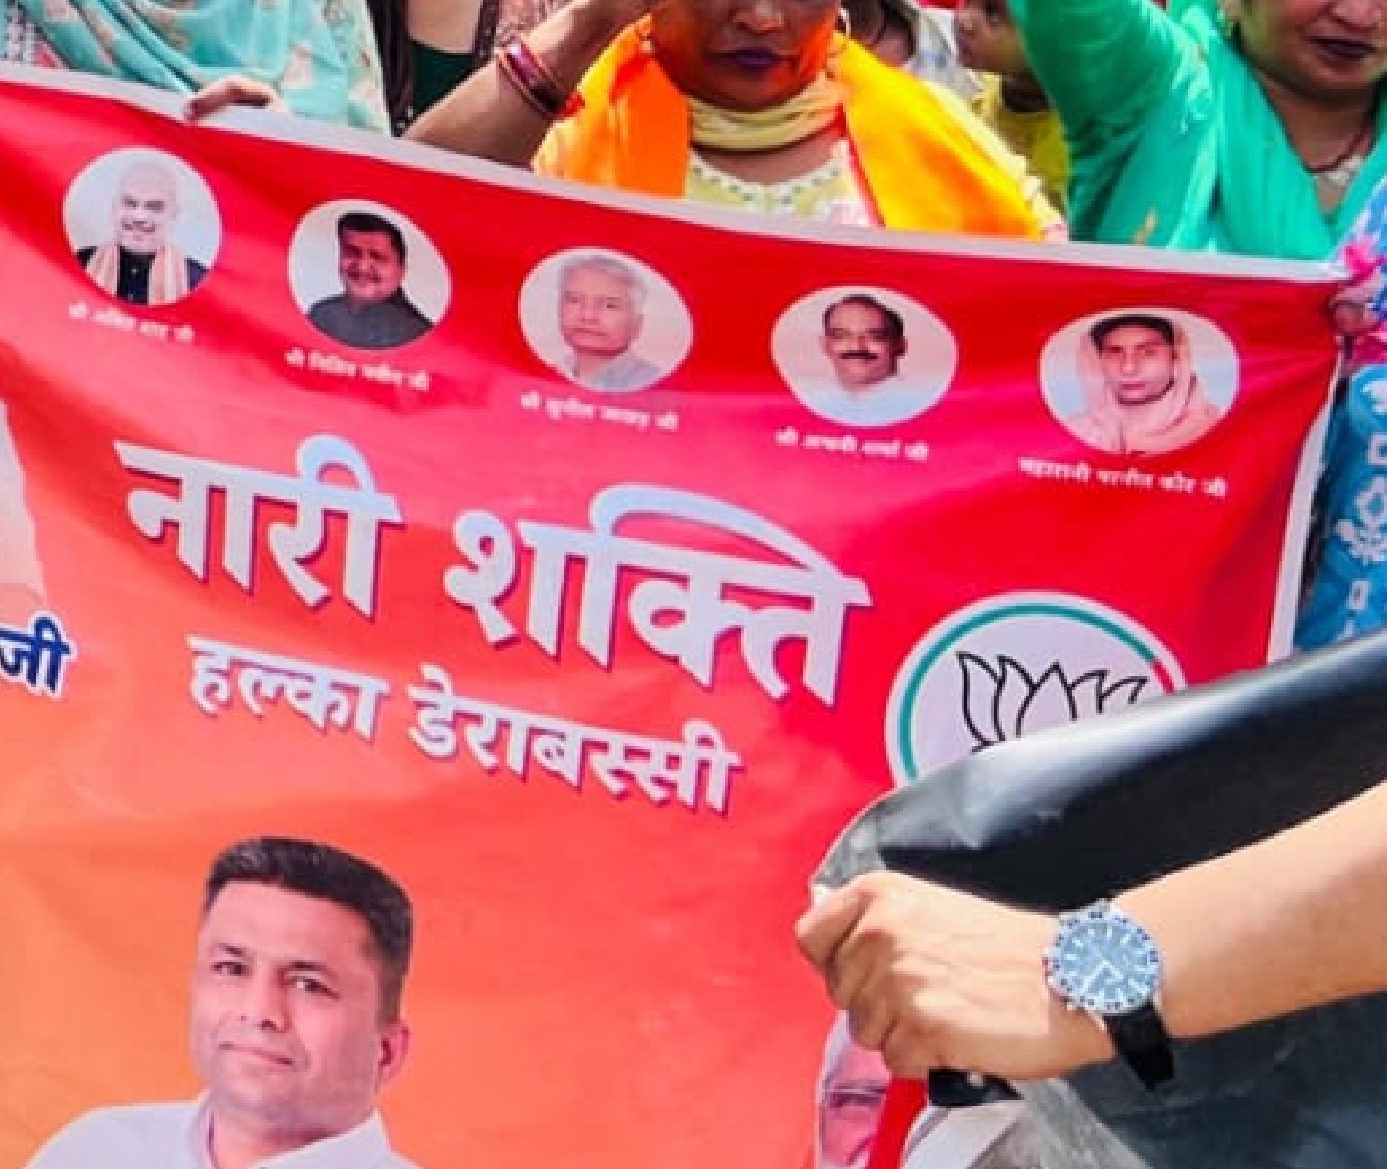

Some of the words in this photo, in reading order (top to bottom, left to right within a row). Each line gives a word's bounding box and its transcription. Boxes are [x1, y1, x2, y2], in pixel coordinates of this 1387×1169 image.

[113, 435, 403, 616] नारी
[443, 484, 871, 705] शक्ति
[189, 637, 391, 741] हल्का
[407, 663, 746, 812] डेराबस्सी
